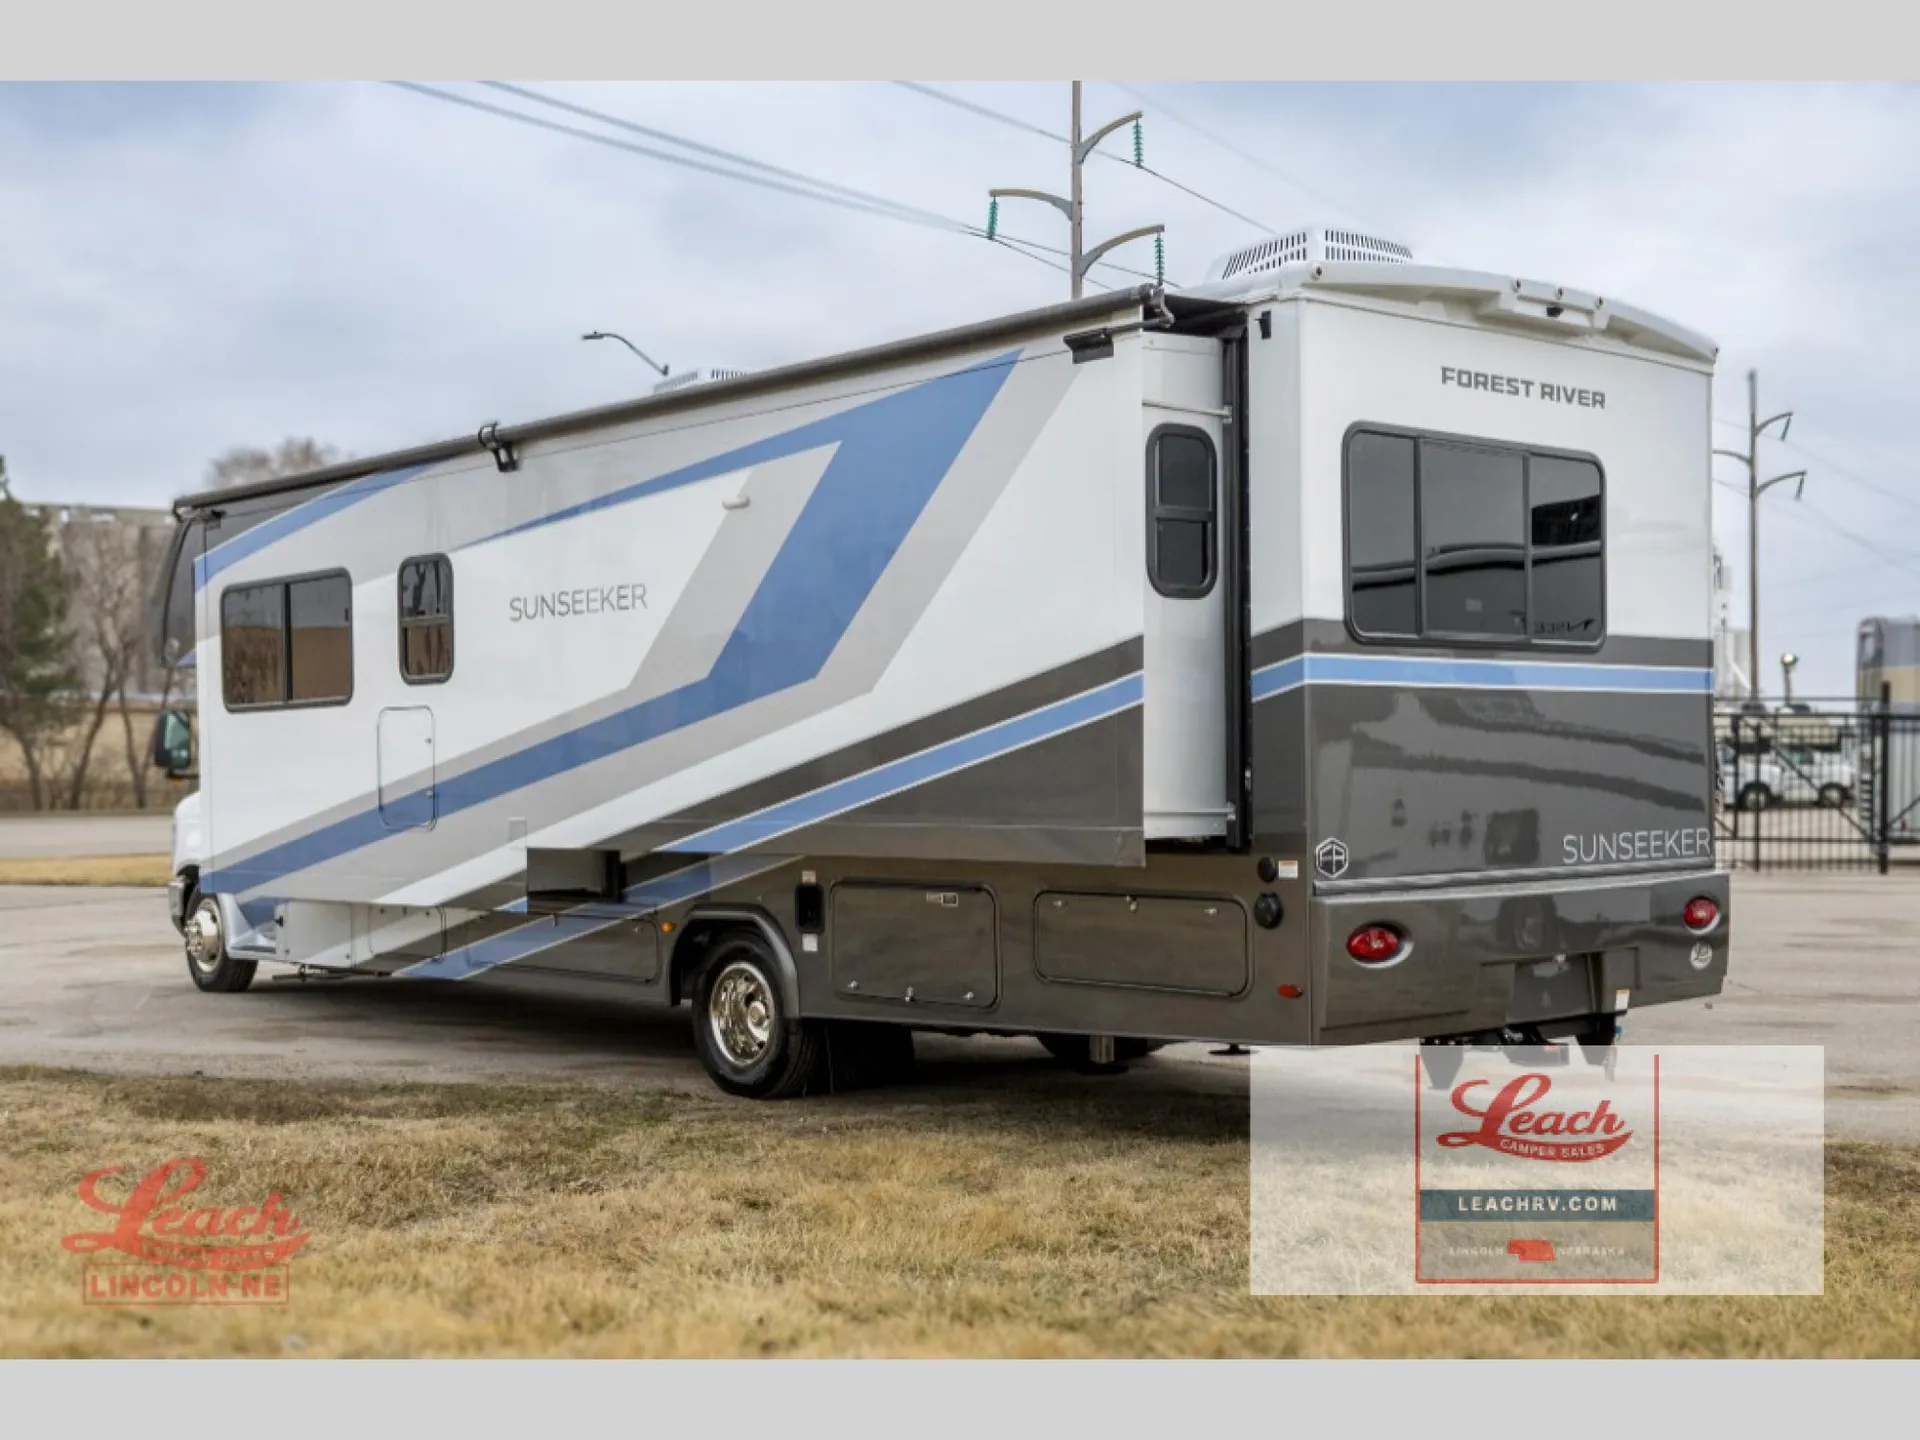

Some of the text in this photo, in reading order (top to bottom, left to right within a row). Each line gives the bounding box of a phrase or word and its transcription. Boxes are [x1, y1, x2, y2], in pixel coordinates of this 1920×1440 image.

[1441, 366, 1605, 409] FOREST RIVER
[509, 583, 647, 622] SUNSEEKER
[1563, 827, 1711, 864] SUNSEEKER
